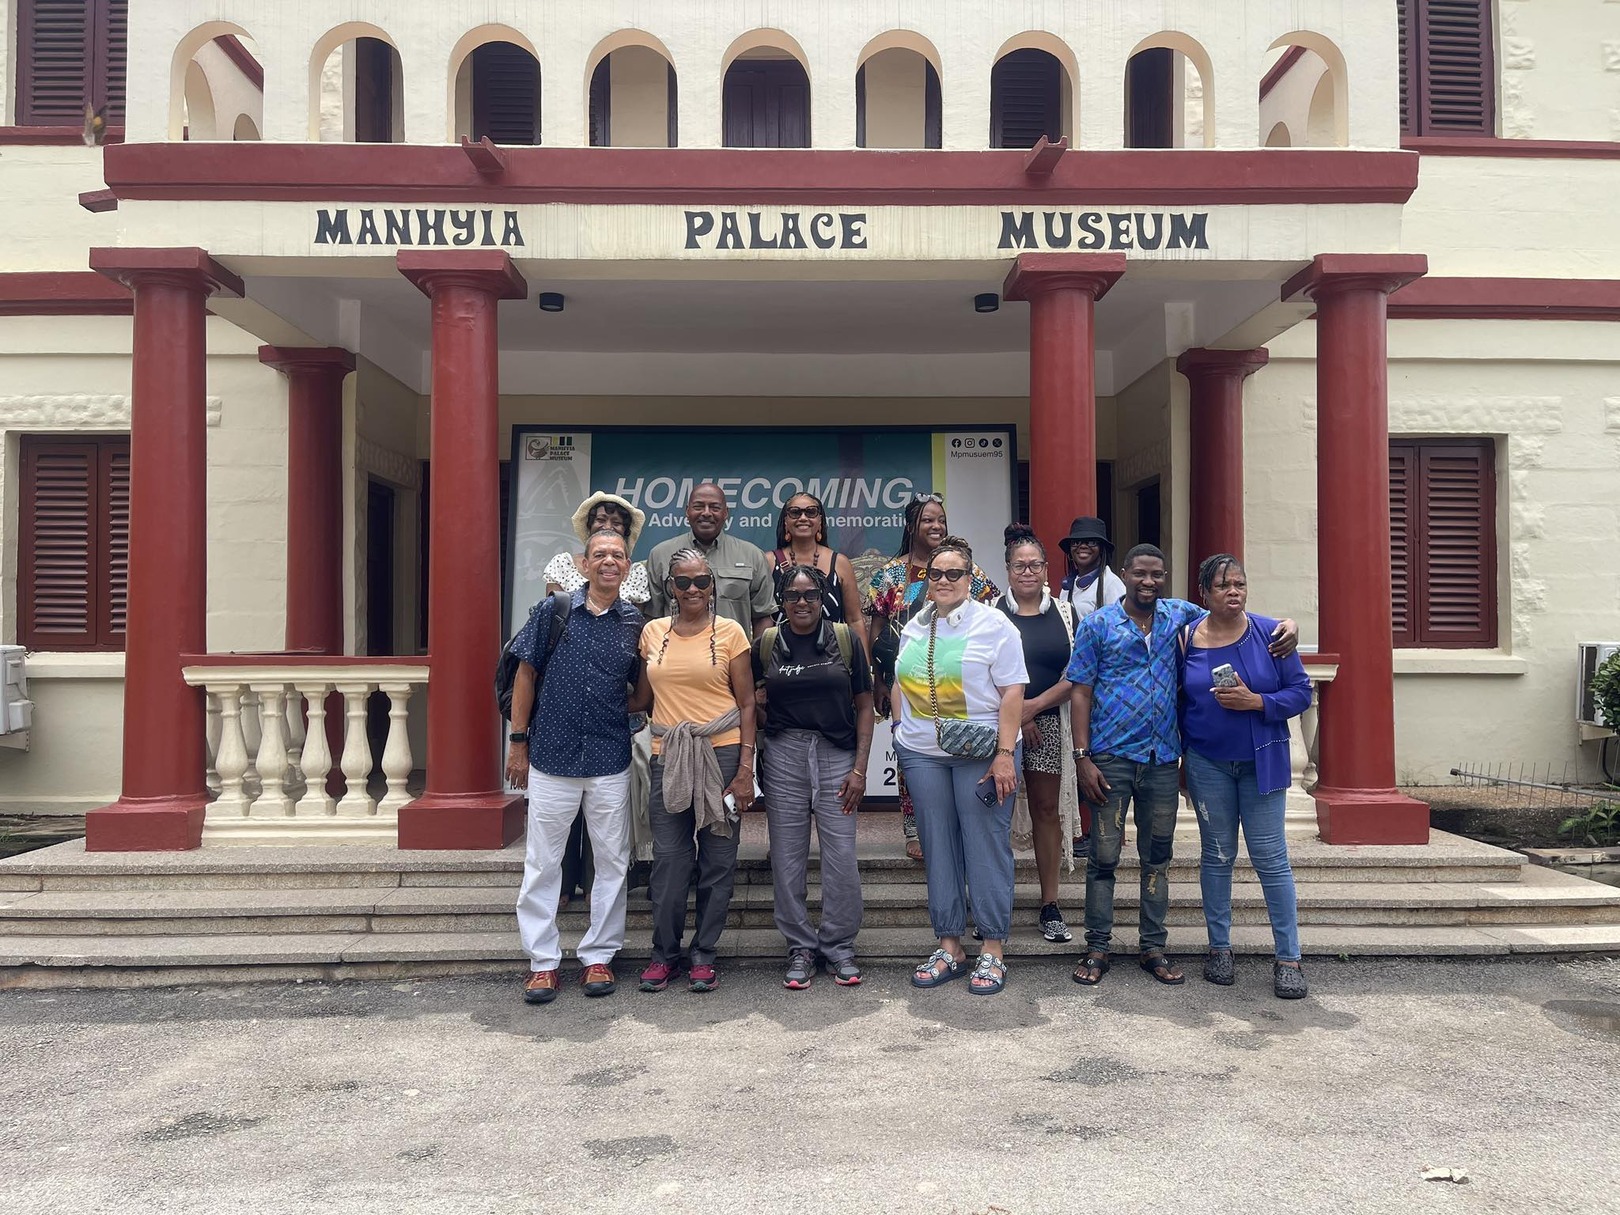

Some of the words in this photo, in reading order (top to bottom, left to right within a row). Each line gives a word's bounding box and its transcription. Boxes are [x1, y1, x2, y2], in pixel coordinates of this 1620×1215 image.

[314, 209, 525, 246] MANHYIA
[684, 211, 867, 249] PALACE
[997, 211, 1210, 250] MUSEUM
[740, 513, 772, 527] and
[883, 767, 897, 786] 2
